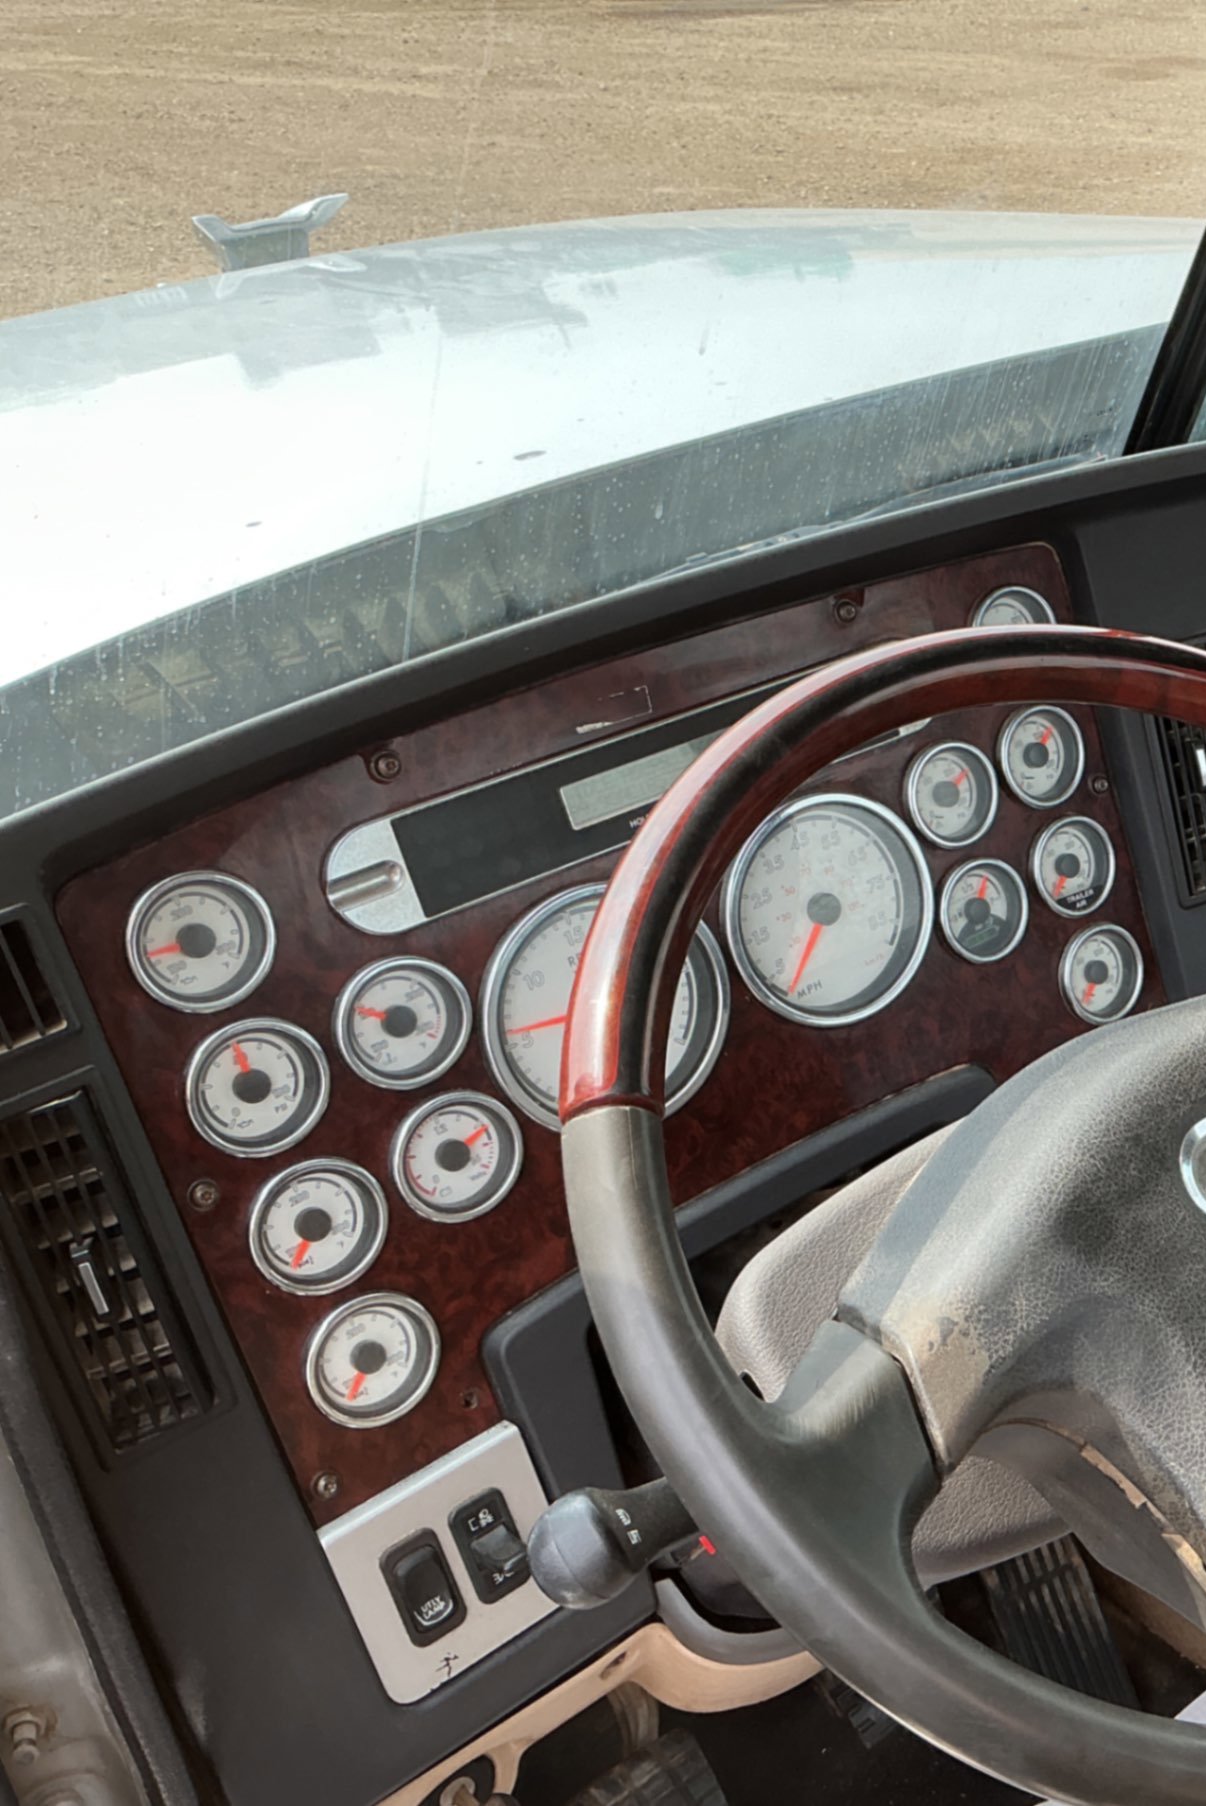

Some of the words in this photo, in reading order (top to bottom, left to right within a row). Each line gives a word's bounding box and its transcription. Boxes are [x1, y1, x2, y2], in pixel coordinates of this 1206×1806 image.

[1066, 889, 1095, 904] TRAILER
[523, 970, 545, 991] 10
[797, 979, 822, 998] MPH
[522, 1030, 534, 1049] 5
